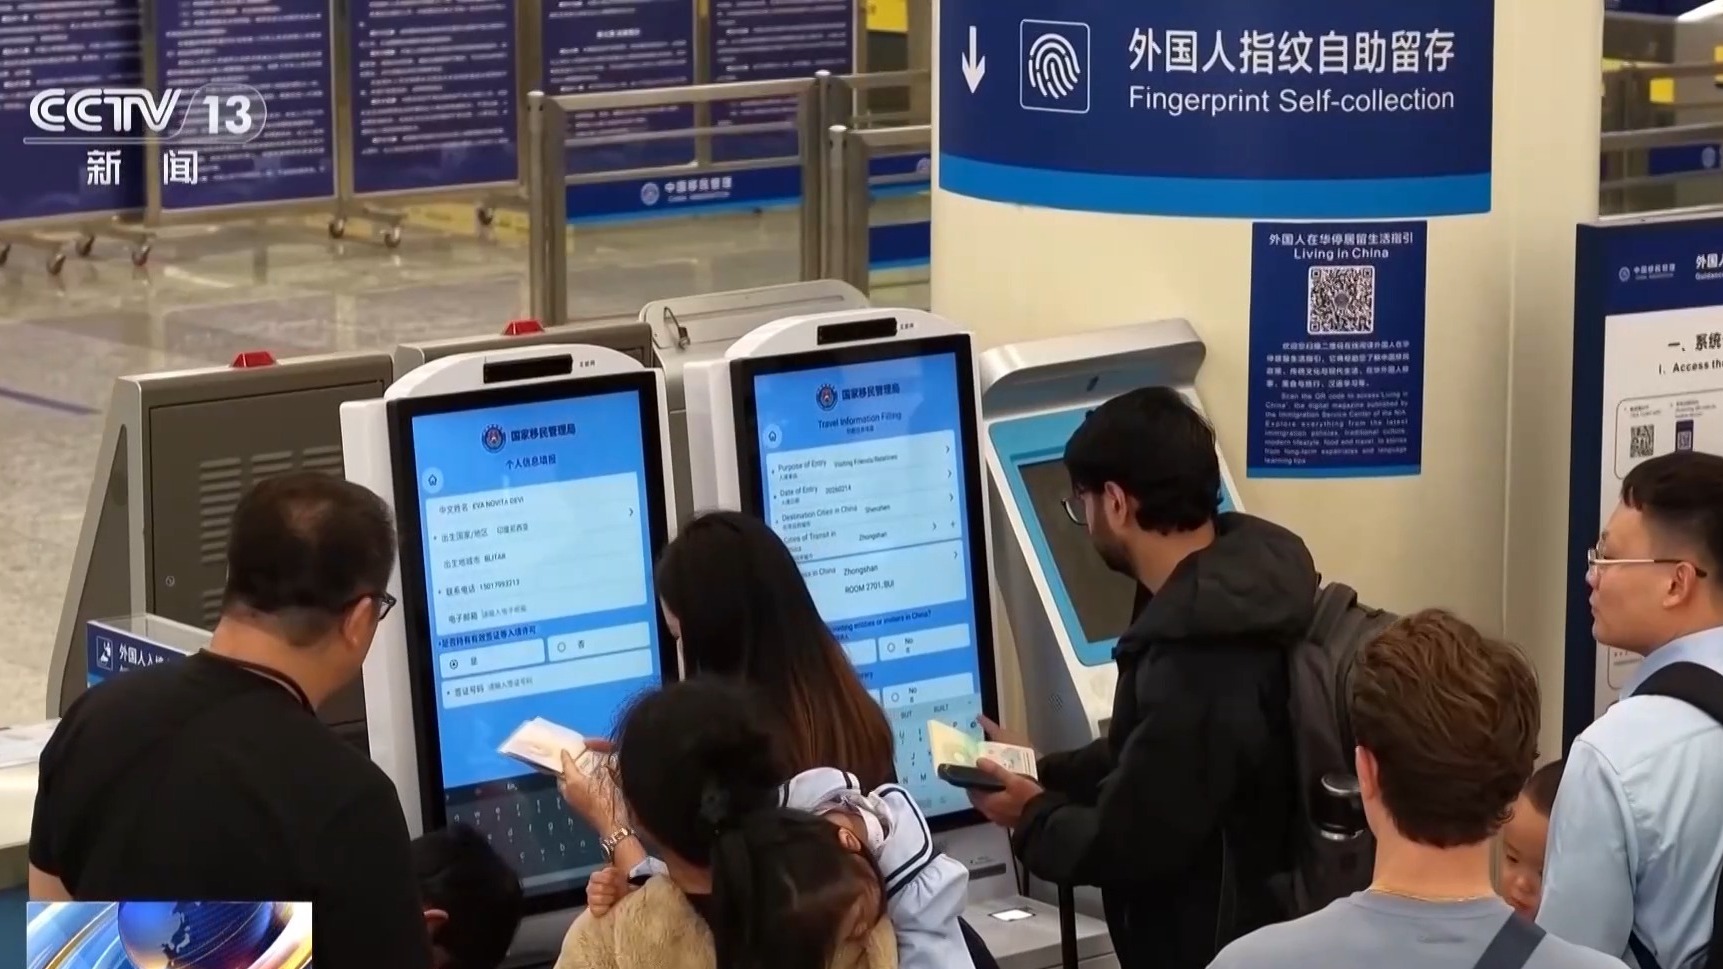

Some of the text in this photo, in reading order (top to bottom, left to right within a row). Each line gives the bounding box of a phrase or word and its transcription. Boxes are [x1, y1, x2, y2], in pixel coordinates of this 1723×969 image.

[1128, 27, 1456, 75] 外国人指纹自助留存
[1129, 85, 1456, 117] Fingerprint Self-collection
[1269, 232, 1413, 246] 外国人在华停居留生活指引
[1294, 247, 1389, 260] Living in China
[1672, 361, 1709, 373] Access
[841, 382, 901, 401] 国家移民管理局
[817, 411, 902, 429] Travel Information Filling
[510, 422, 577, 442] 国家移民管理局
[505, 453, 557, 470] 个人信息填报
[778, 463, 803, 473] Purpose
[804, 461, 810, 469] of
[811, 459, 826, 469] Entry
[780, 488, 795, 498] Date
[795, 486, 801, 495] of
[802, 485, 818, 495] Entry
[472, 501, 486, 510] EVA
[486, 497, 509, 508] NOVITA
[782, 511, 815, 522] Destination
[816, 507, 833, 517] Cities
[841, 505, 858, 514] China
[802, 532, 808, 542] of
[809, 531, 830, 540] Transit
[831, 530, 837, 538] in
[819, 566, 836, 576] China
[843, 564, 878, 576] Zhongshan
[844, 582, 866, 594] ROOM
[904, 638, 913, 646] No
[909, 687, 917, 695] No
[901, 711, 912, 720] BUT
